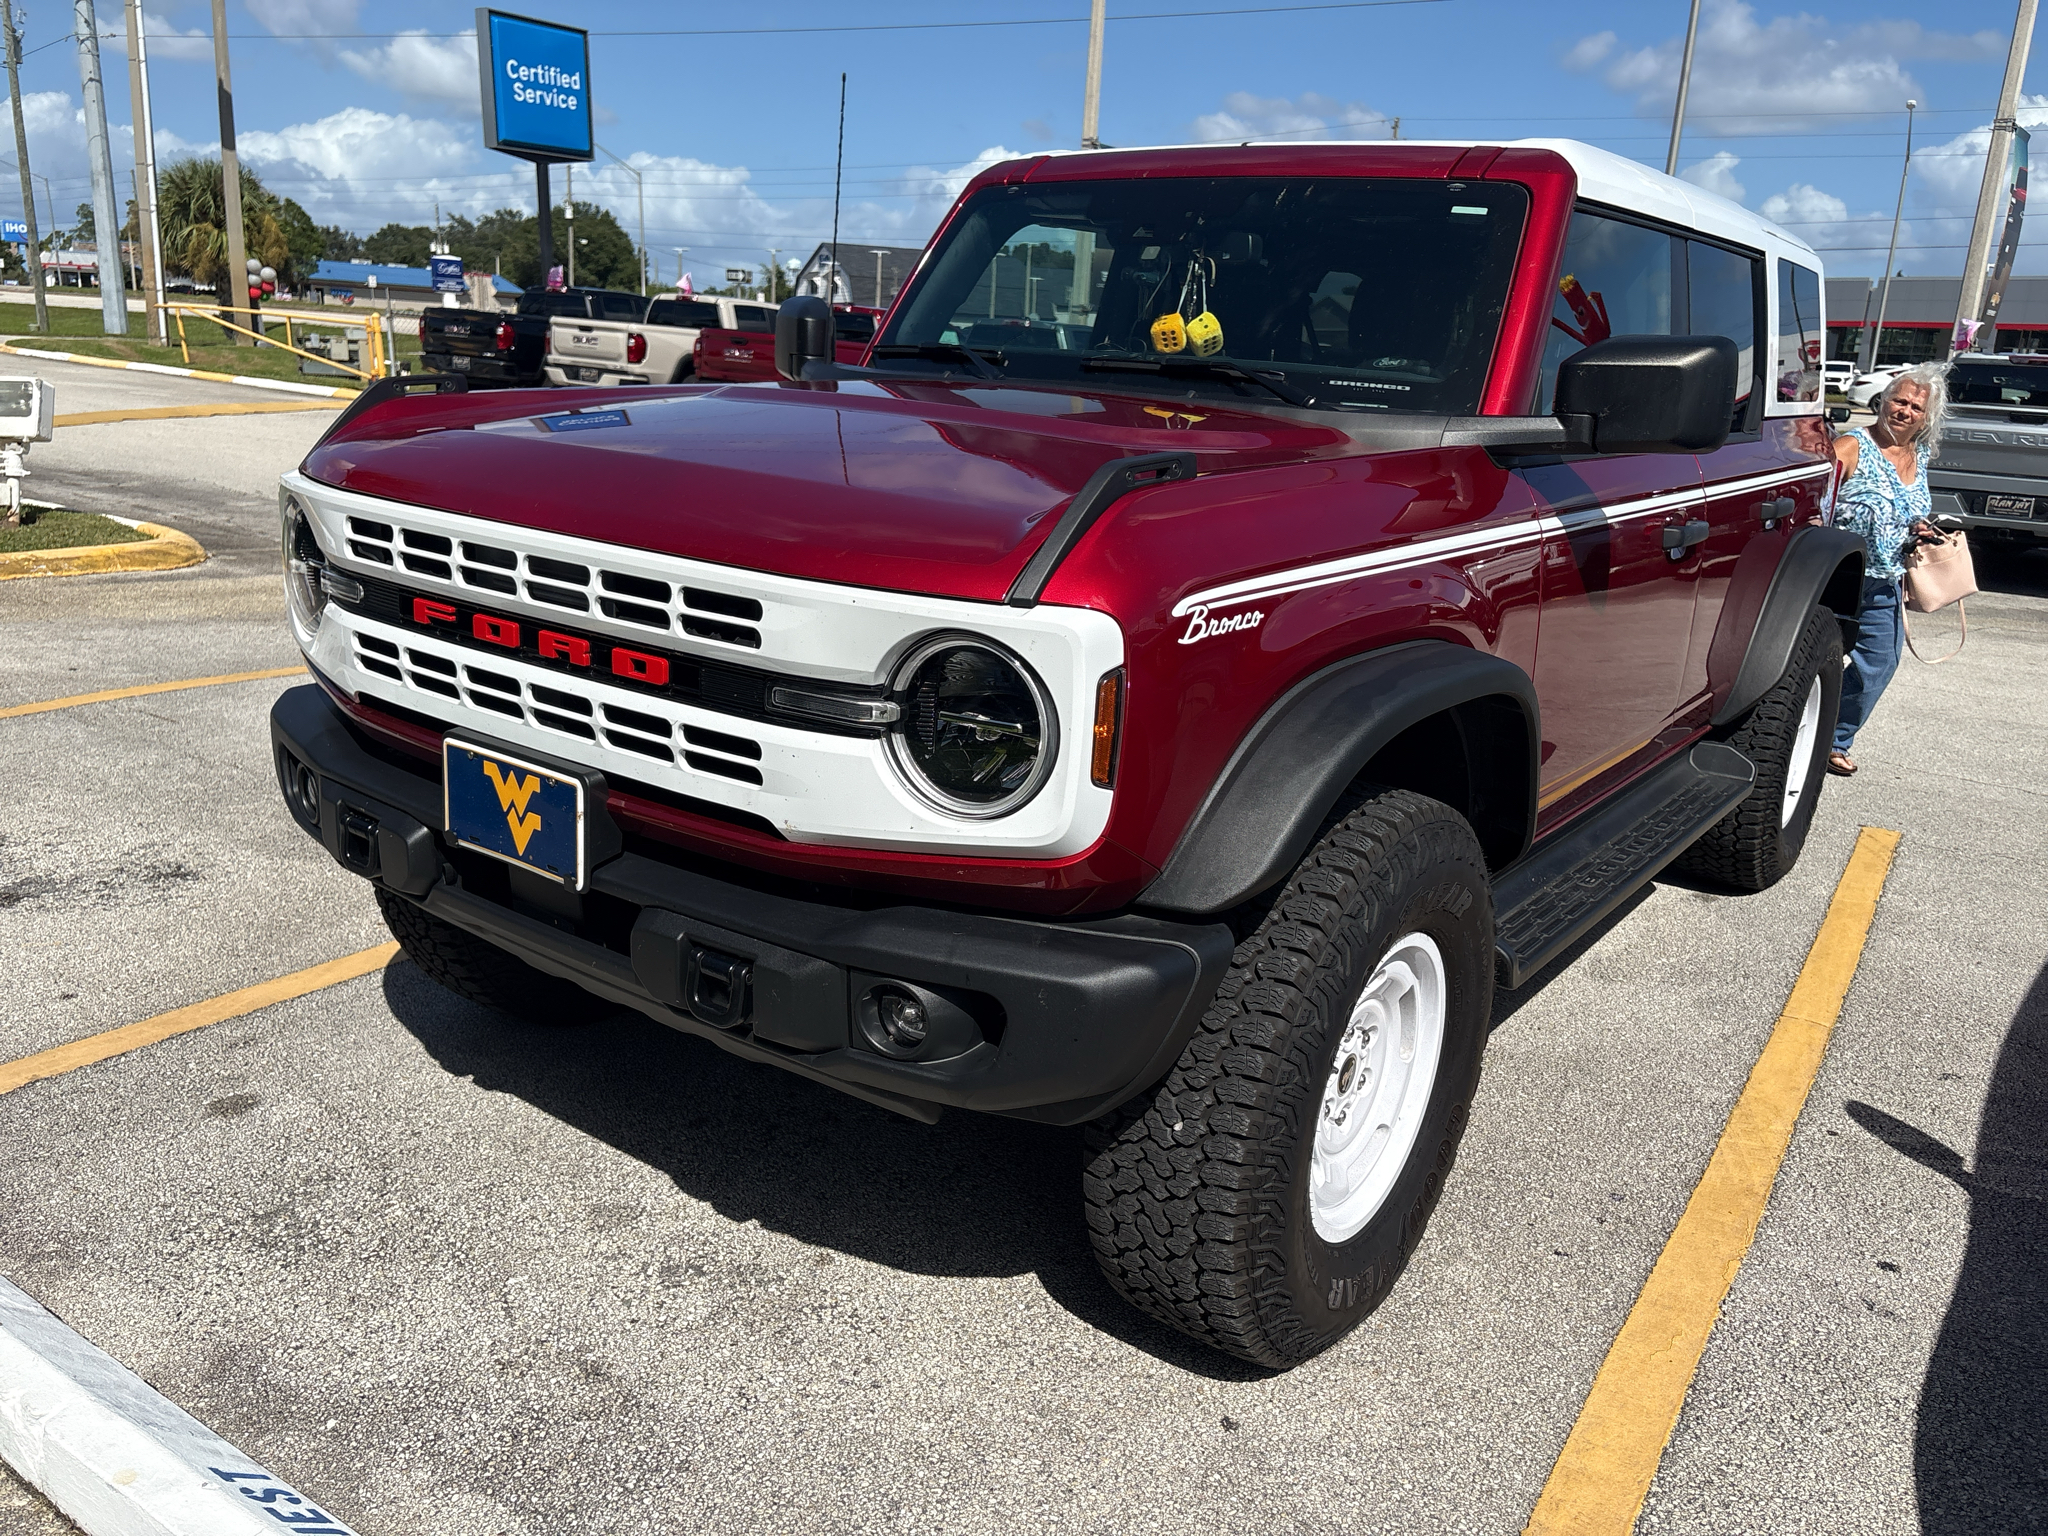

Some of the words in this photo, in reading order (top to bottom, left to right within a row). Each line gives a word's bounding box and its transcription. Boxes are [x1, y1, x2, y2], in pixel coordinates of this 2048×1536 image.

[506, 59, 581, 91] Certified
[513, 82, 578, 110] Service
[5, 222, 28, 233] IHO
[1329, 380, 1411, 391] BRONCO
[1940, 429, 2048, 448] HEVR
[1989, 499, 2014, 508] ALAN
[2012, 501, 2031, 510] JAY
[1177, 605, 1265, 645] Bronco
[413, 597, 670, 686] FORD
